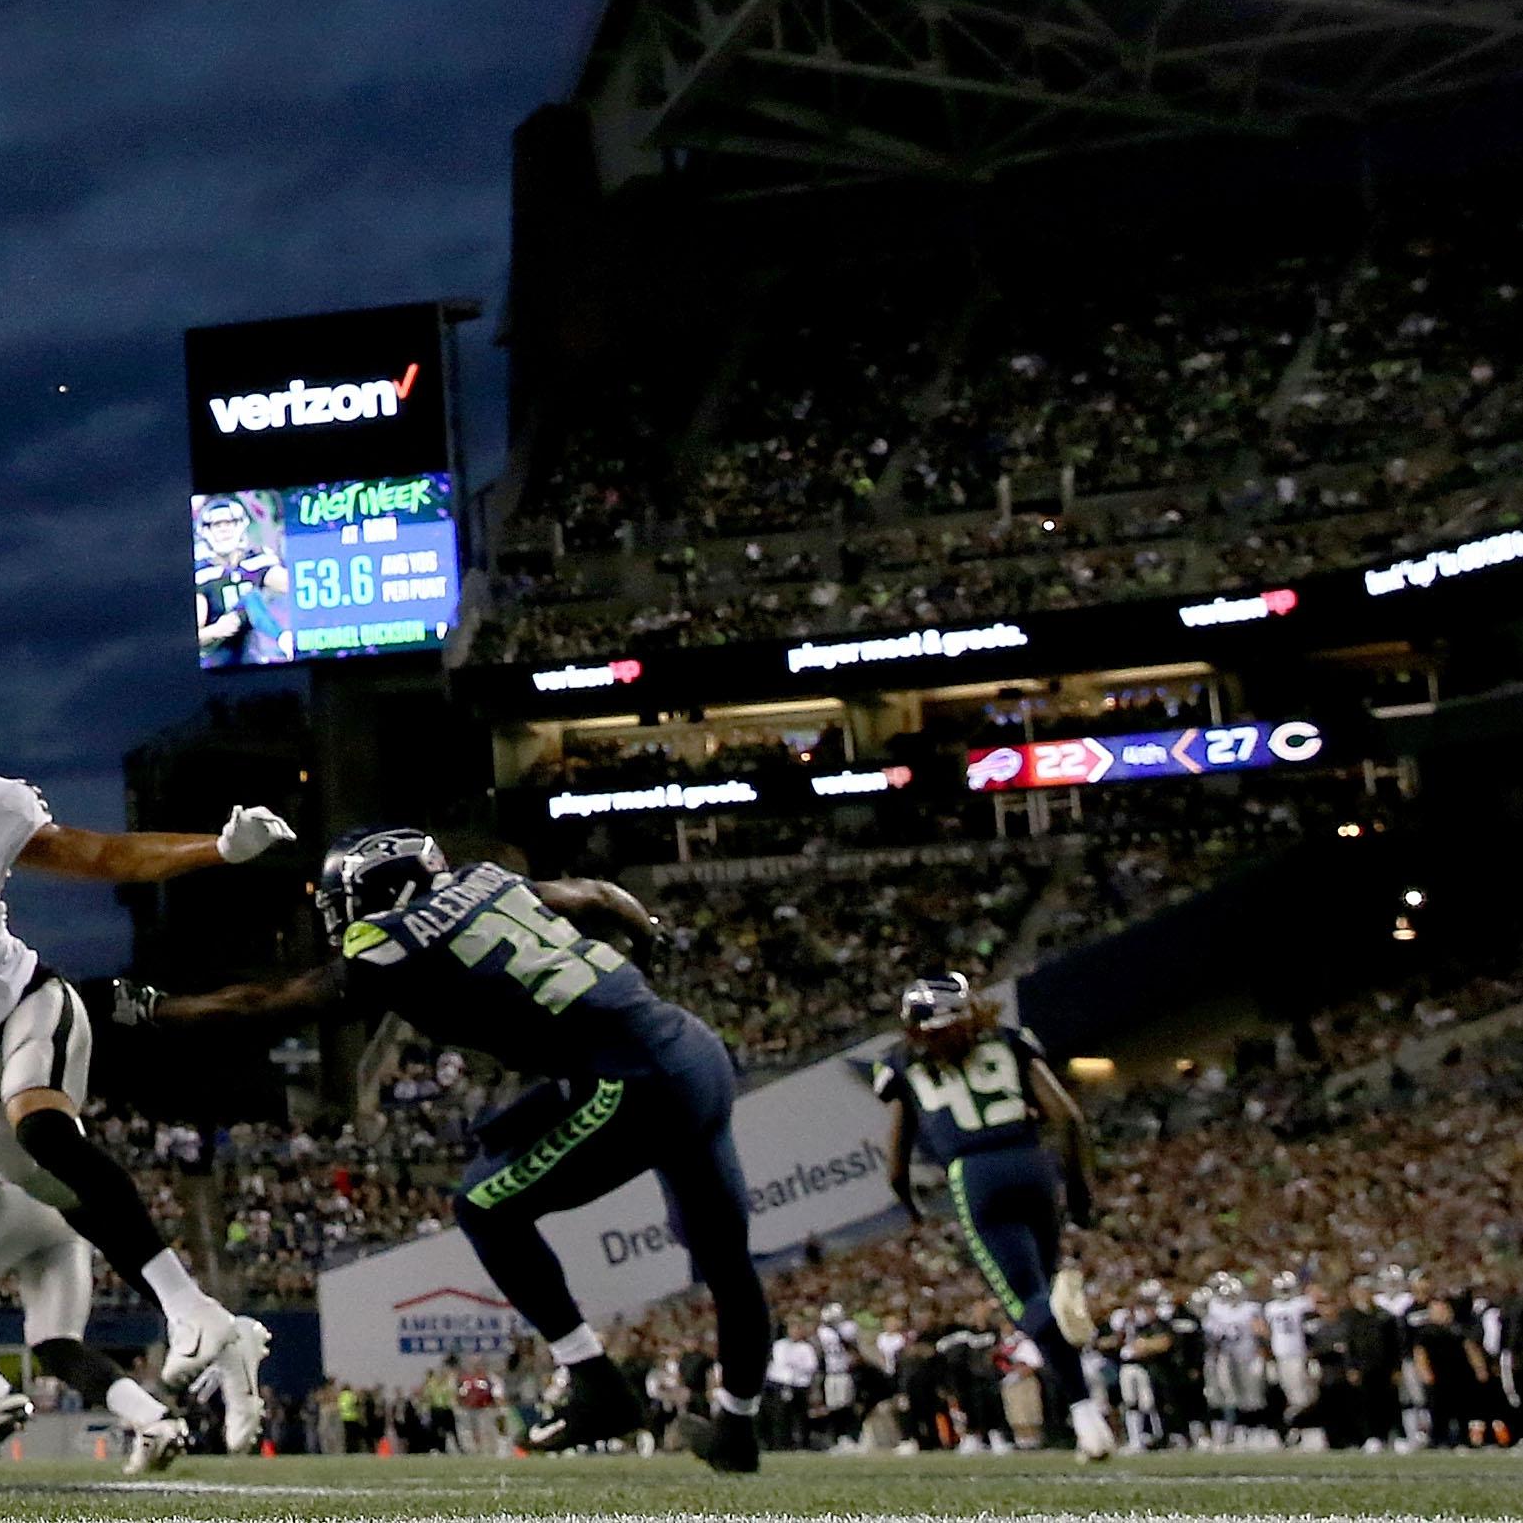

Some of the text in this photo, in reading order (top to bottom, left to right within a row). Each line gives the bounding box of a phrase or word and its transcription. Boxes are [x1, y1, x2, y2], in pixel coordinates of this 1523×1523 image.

[209, 379, 398, 433] verizon
[294, 554, 374, 610] 53.6
[1034, 745, 1088, 779] 22
[1204, 726, 1259, 765] 27
[599, 1222, 676, 1266] Dre
